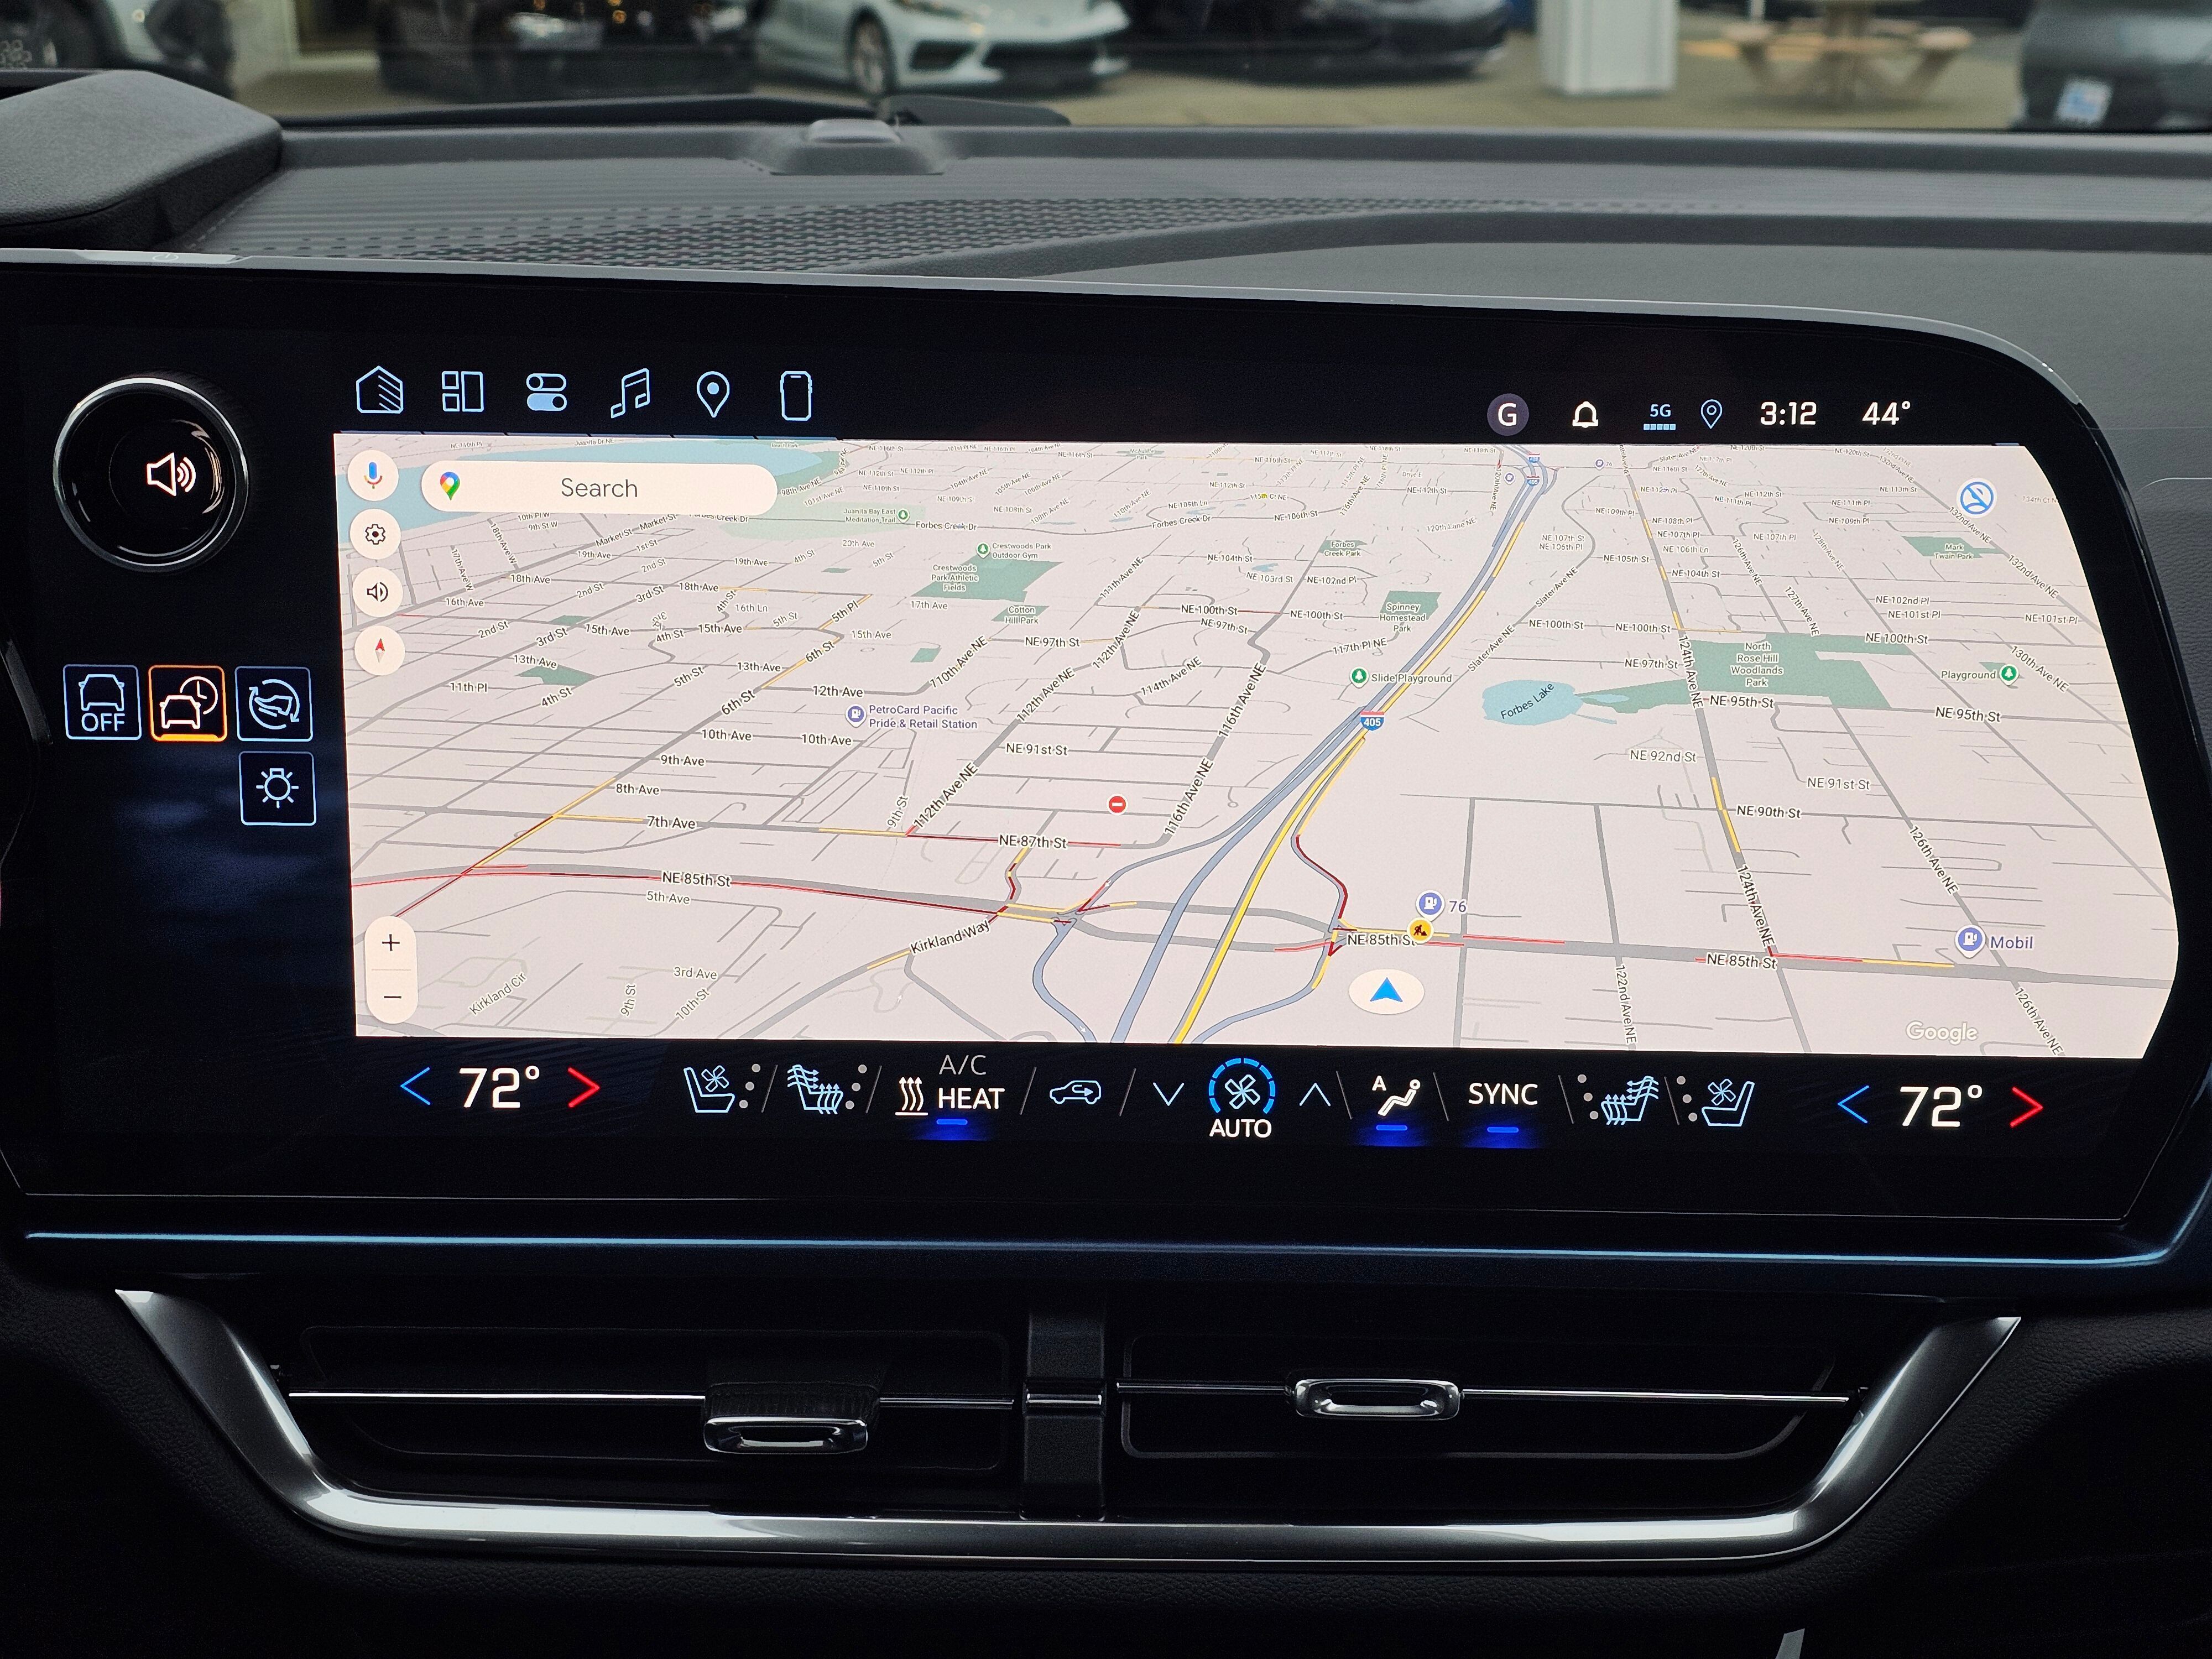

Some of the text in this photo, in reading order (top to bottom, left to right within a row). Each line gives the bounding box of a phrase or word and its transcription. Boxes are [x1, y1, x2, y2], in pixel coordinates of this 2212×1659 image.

[1499, 404, 1516, 427] G
[1650, 405, 1671, 417] 5G
[1761, 403, 1817, 425] 3:12
[562, 478, 638, 497] Search
[1287, 512, 1308, 520] 106th
[535, 575, 550, 583] Ave
[2008, 555, 2058, 598] 132nd Ave NE
[680, 582, 718, 592] 18th Ave
[1182, 606, 1195, 614] NE
[1226, 607, 1237, 615] St
[1387, 603, 1420, 612] Spinney
[586, 624, 630, 636] 15th Ave
[1660, 625, 1670, 633] St
[536, 628, 567, 646] 3rd St
[1866, 633, 1928, 644] NE 100th St
[514, 655, 556, 669] 13th Ave
[1679, 637, 1702, 707] 124th Ave NE
[1731, 666, 1782, 675] Woodlands
[1942, 671, 1995, 679] Playground
[1399, 675, 1452, 683] Playground
[450, 682, 487, 692] 11th Pl
[813, 686, 863, 697] 12th Ave
[542, 687, 572, 706] 4th St
[722, 690, 755, 714] 6th St
[1219, 662, 1266, 736] 116th Ave NE
[1501, 683, 1554, 719] Forbes Lake
[1710, 696, 1773, 708] NE 95th St
[869, 706, 958, 714] PetroCard Pacific
[1936, 707, 2000, 722] NE 95th St
[81, 712, 124, 732] OFF
[702, 730, 751, 740] 10th Ave
[1006, 744, 1067, 755] NE 91st St
[661, 755, 705, 765] 9th Ave
[1630, 751, 1696, 761] NE 92nd St
[616, 784, 659, 795] 8th Ave
[1737, 806, 1800, 818] NE 90th St
[647, 817, 695, 830] 7th Ave
[999, 836, 1067, 848] NE 87th St
[1910, 826, 1959, 894] 126th Ave NE
[663, 873, 731, 886] NE 85th St
[1449, 901, 1467, 912] 76
[911, 920, 989, 954] Kirkland Way
[1991, 937, 2033, 948] Mobil
[1707, 954, 1776, 969] NE 85th St
[469, 973, 526, 1015] Kirkland Cir
[676, 989, 709, 1020] 10th St
[1906, 1022, 1978, 1042] Google
[939, 1054, 987, 1076] A/C
[938, 1088, 1004, 1110] HEAT
[1469, 1083, 1537, 1105] SYNC
[1210, 1119, 1271, 1138] AUTO
